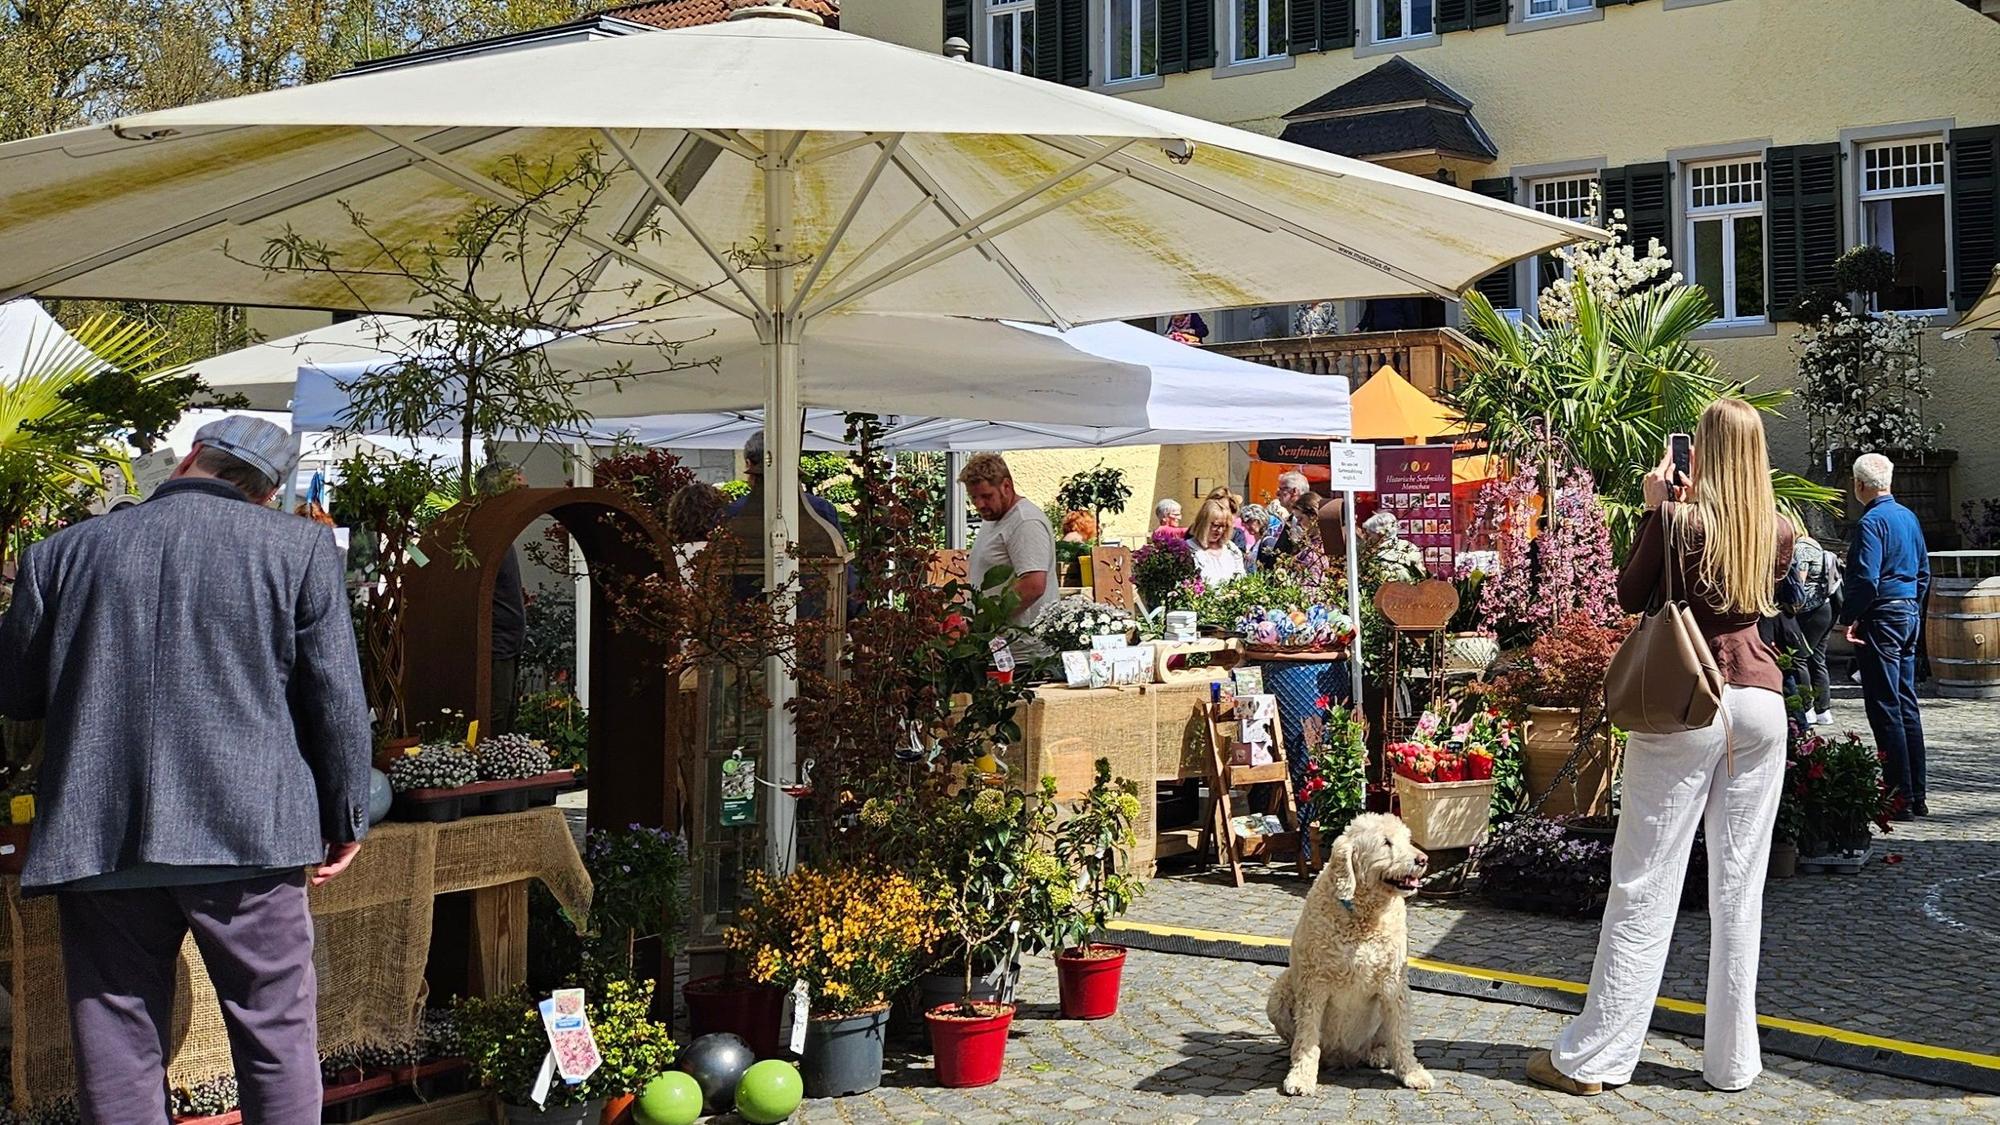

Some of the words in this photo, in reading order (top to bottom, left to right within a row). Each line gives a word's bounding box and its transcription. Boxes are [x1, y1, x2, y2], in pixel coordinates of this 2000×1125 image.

[1338, 247, 1391, 271] www.musculus.de
[1278, 445, 1329, 459] Senfmühle
[1386, 475, 1416, 483] Historische
[1416, 474, 1446, 483] Senfmühle
